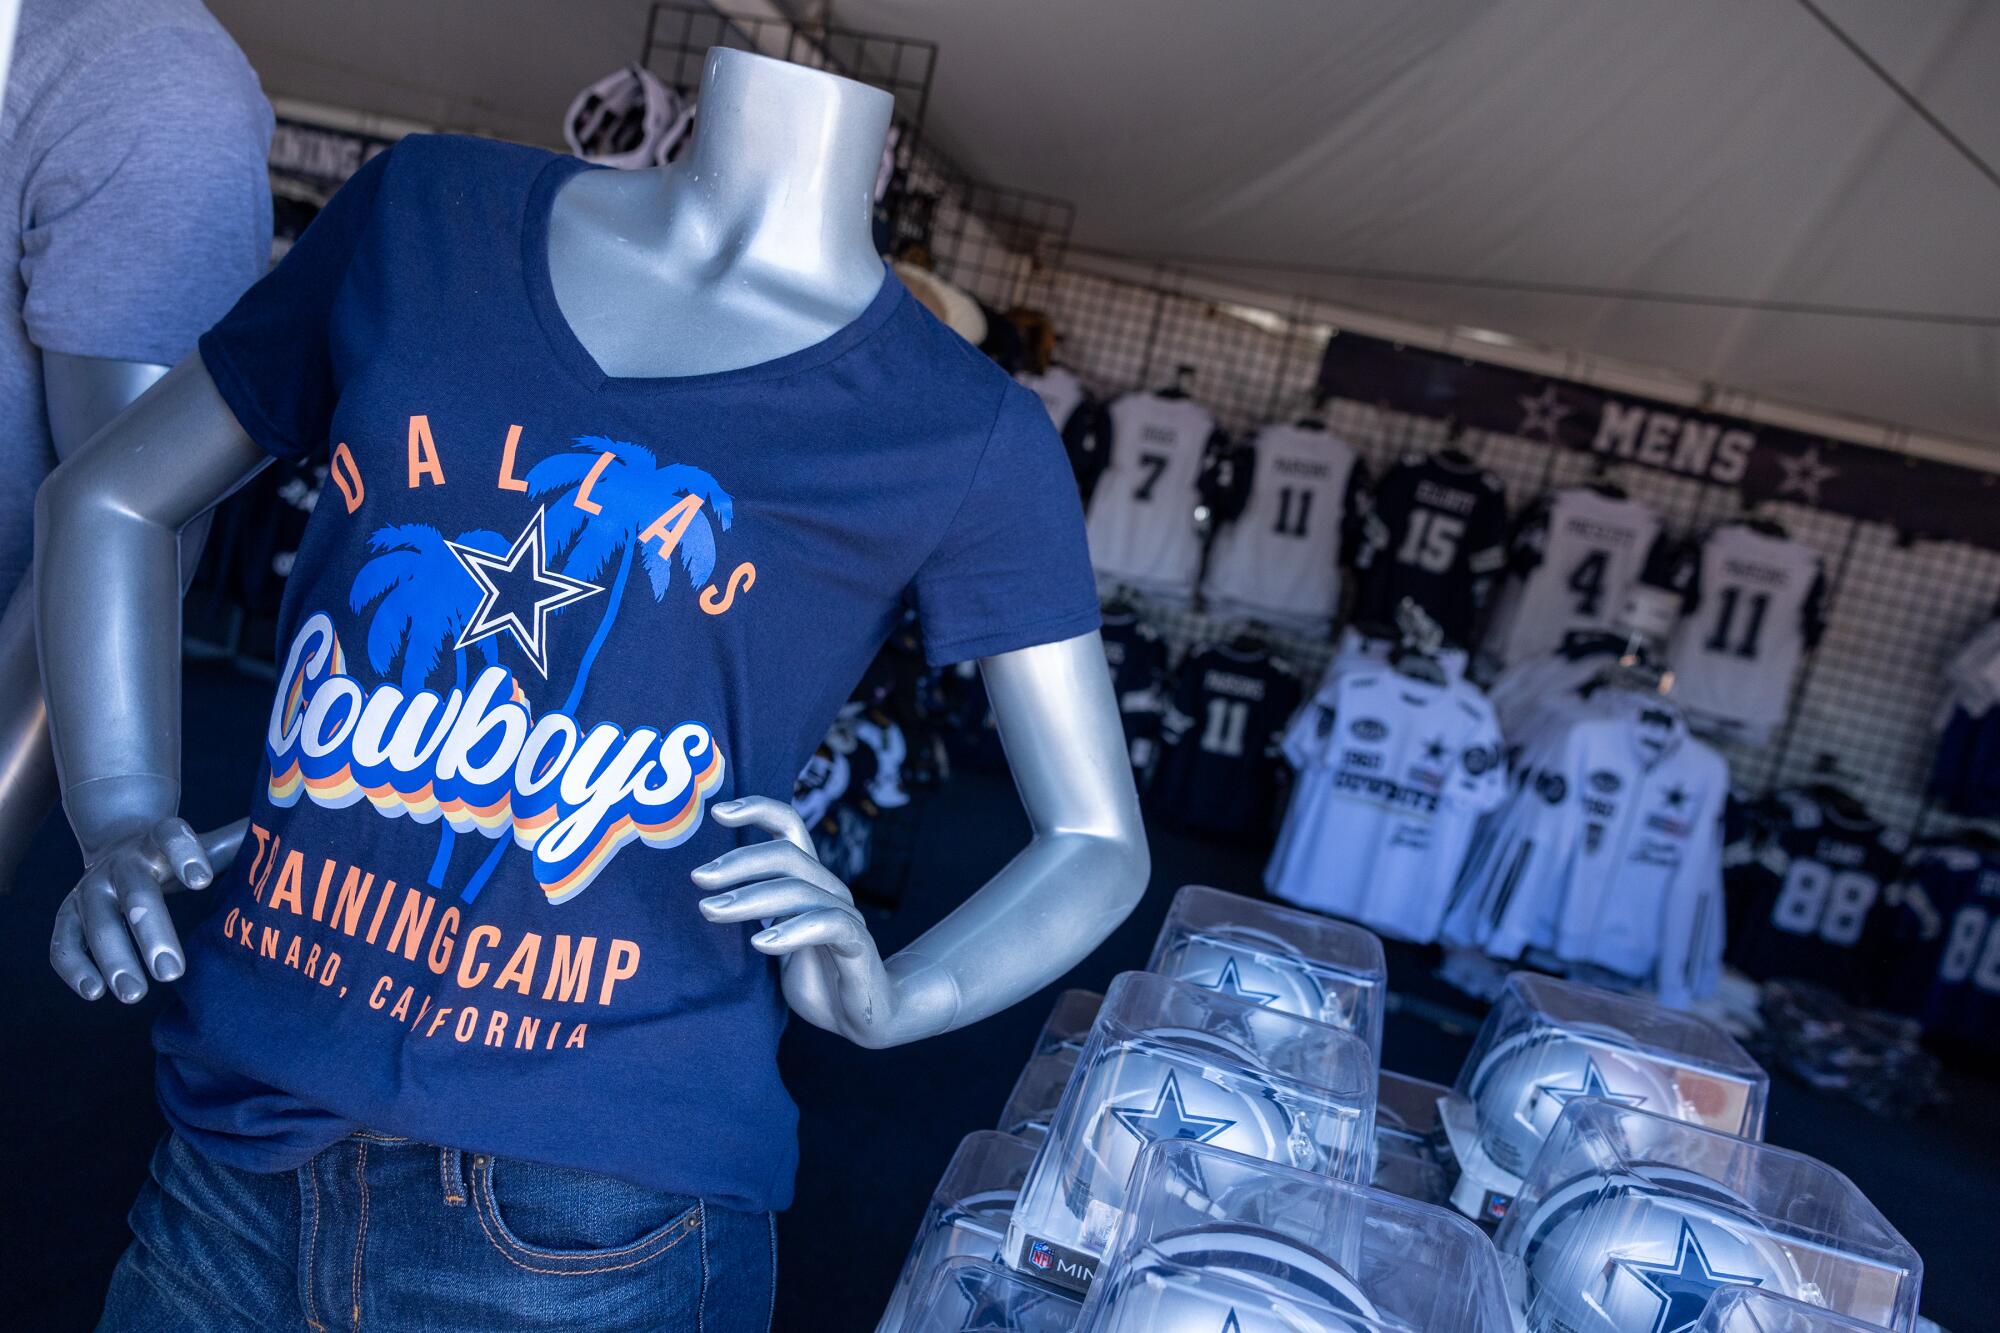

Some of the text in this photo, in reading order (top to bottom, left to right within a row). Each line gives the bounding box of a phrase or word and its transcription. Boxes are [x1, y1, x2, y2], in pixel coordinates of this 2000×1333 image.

[1134, 452, 1170, 500] 7
[1594, 400, 1757, 484] MENS
[331, 415, 756, 615] DALLAS
[1273, 484, 1313, 537] 11
[1396, 508, 1466, 574] 15
[1568, 549, 1610, 616] 4
[1705, 586, 1770, 659] 11
[268, 612, 718, 884] Cowboys
[1202, 699, 1249, 756] 11
[249, 822, 641, 1005] TRAINING CAMP
[1772, 859, 1878, 945] 88
[224, 907, 588, 1050] OXNARD, CALFORNIA
